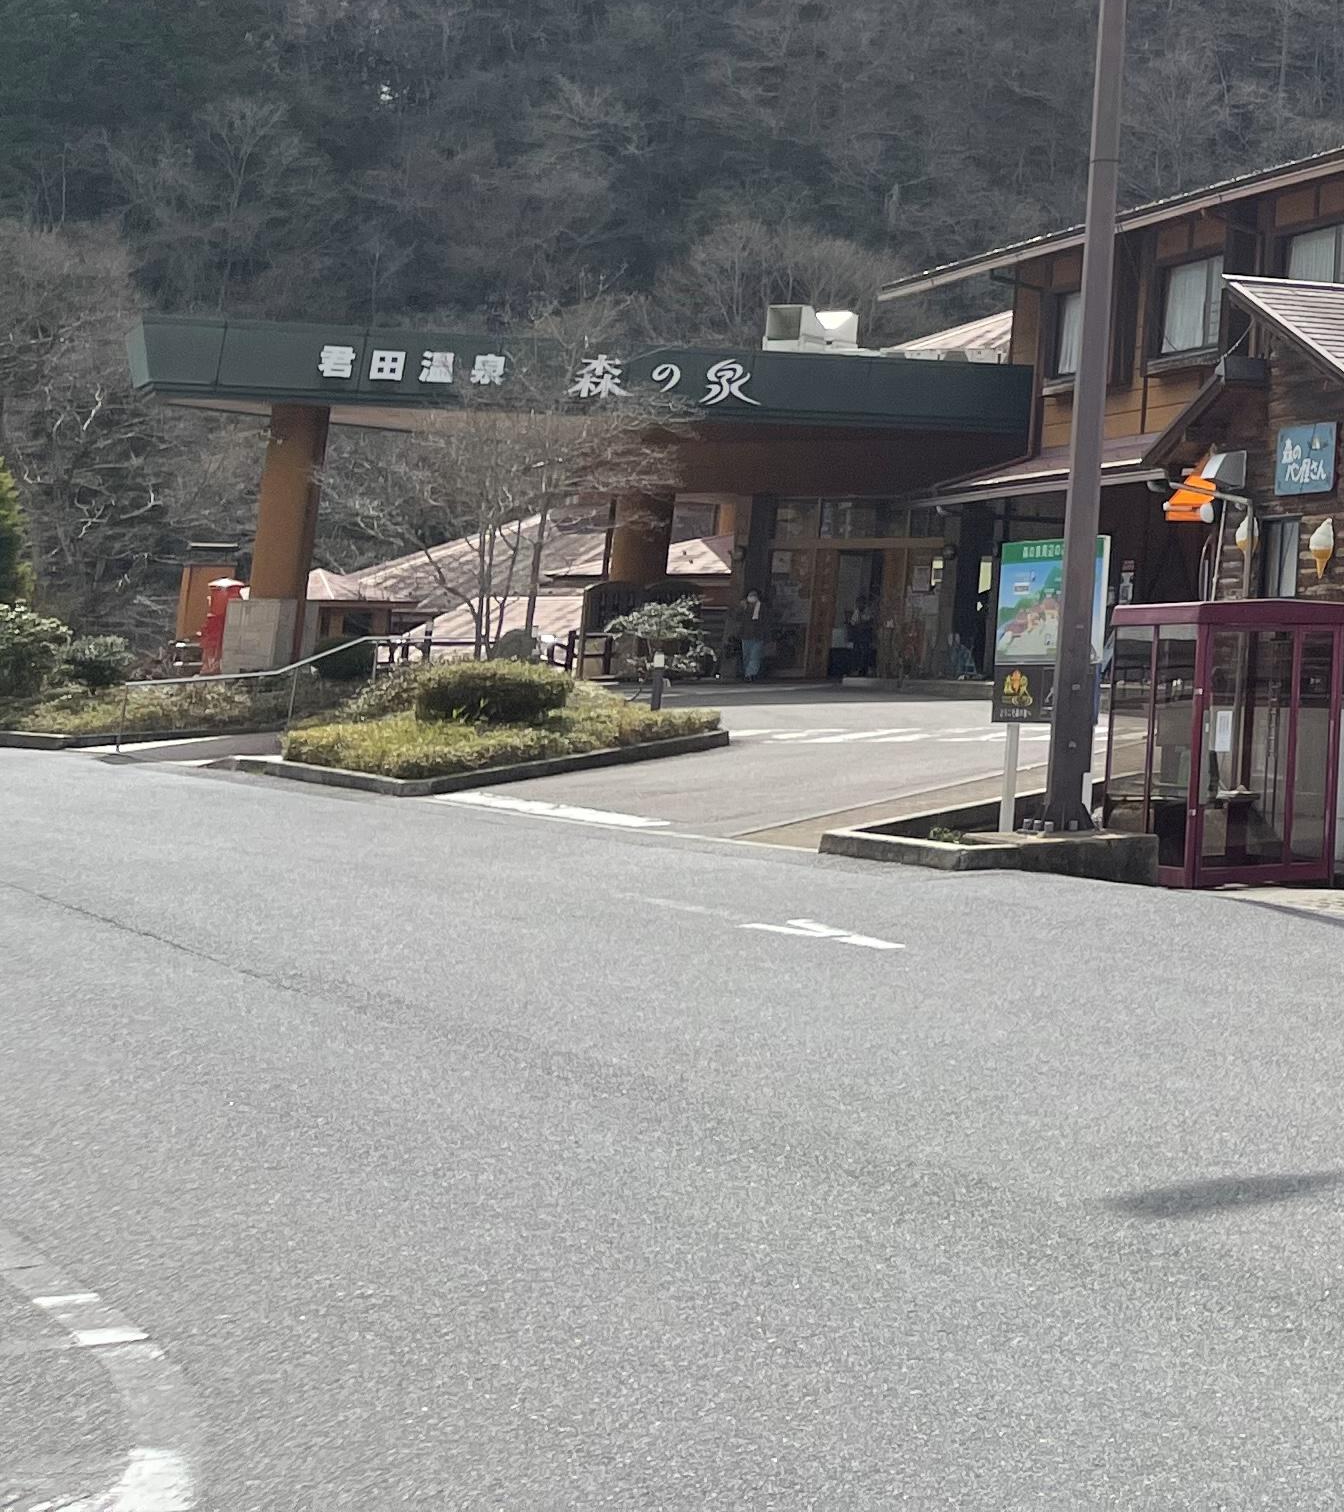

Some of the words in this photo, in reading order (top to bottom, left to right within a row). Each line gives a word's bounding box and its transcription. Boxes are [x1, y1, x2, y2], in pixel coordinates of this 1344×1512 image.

[318, 344, 506, 386] 君田温泉
[567, 354, 761, 406] 森の泉
[1281, 438, 1301, 464] 森の
[1284, 457, 1327, 483] パン屋さん
